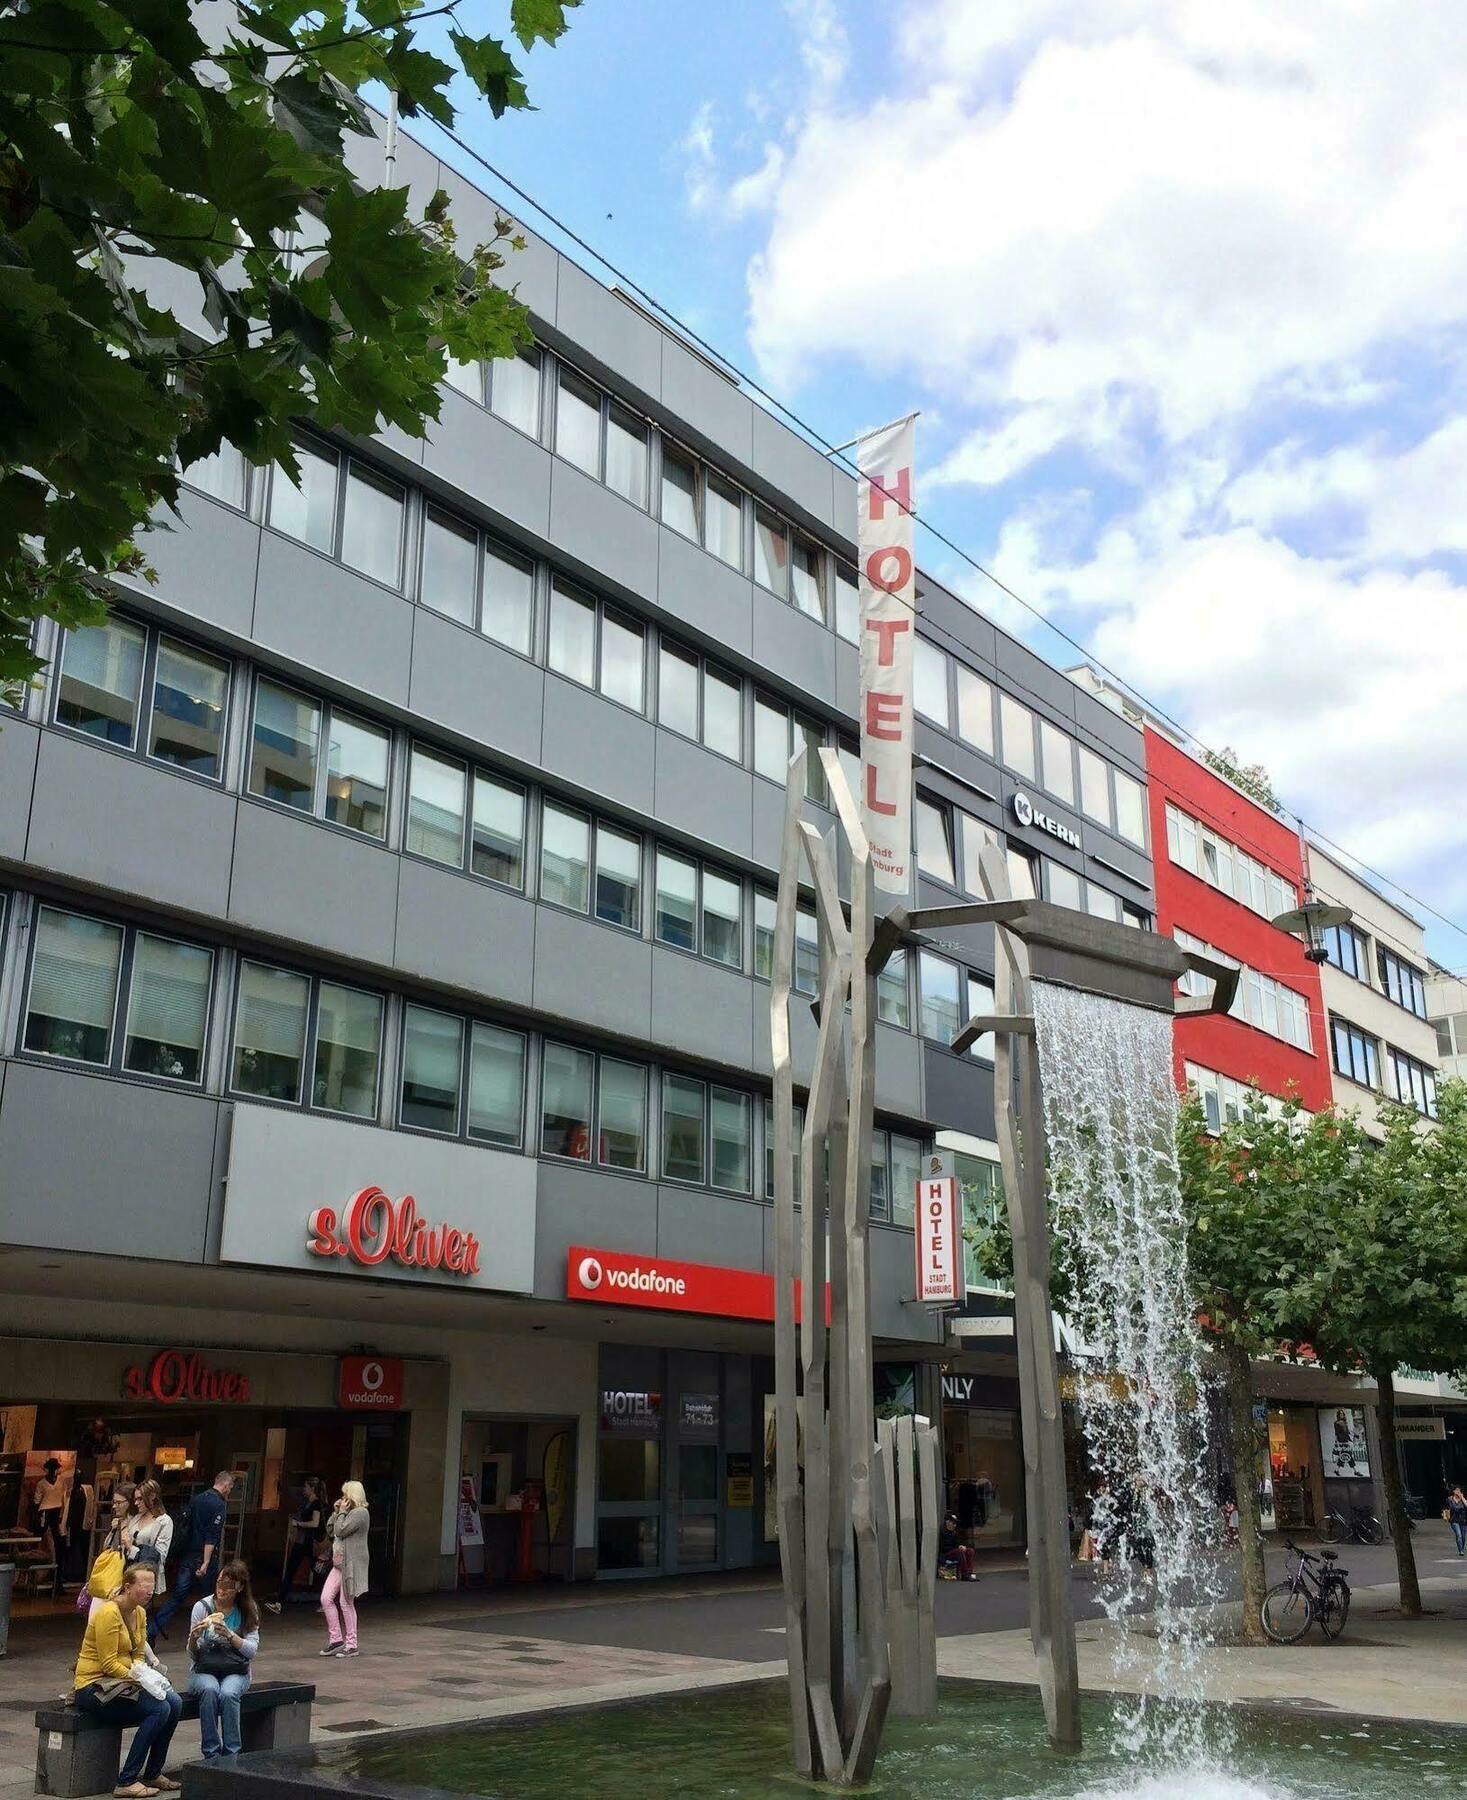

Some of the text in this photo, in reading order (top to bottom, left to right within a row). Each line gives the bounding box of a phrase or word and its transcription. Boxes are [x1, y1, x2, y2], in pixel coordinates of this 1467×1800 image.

[866, 467, 911, 816] HOTEL
[1033, 809, 1080, 848] KERN
[308, 1186, 480, 1274] s.Oliver
[929, 1184, 943, 1269] HOTEL
[606, 1268, 685, 1295] vodafone
[925, 1285, 951, 1294] HAMBURG
[929, 1274, 946, 1283] STADT
[127, 1350, 250, 1404] s.Oliver
[348, 1391, 395, 1404] vodafone
[604, 1391, 653, 1414] HOTEL
